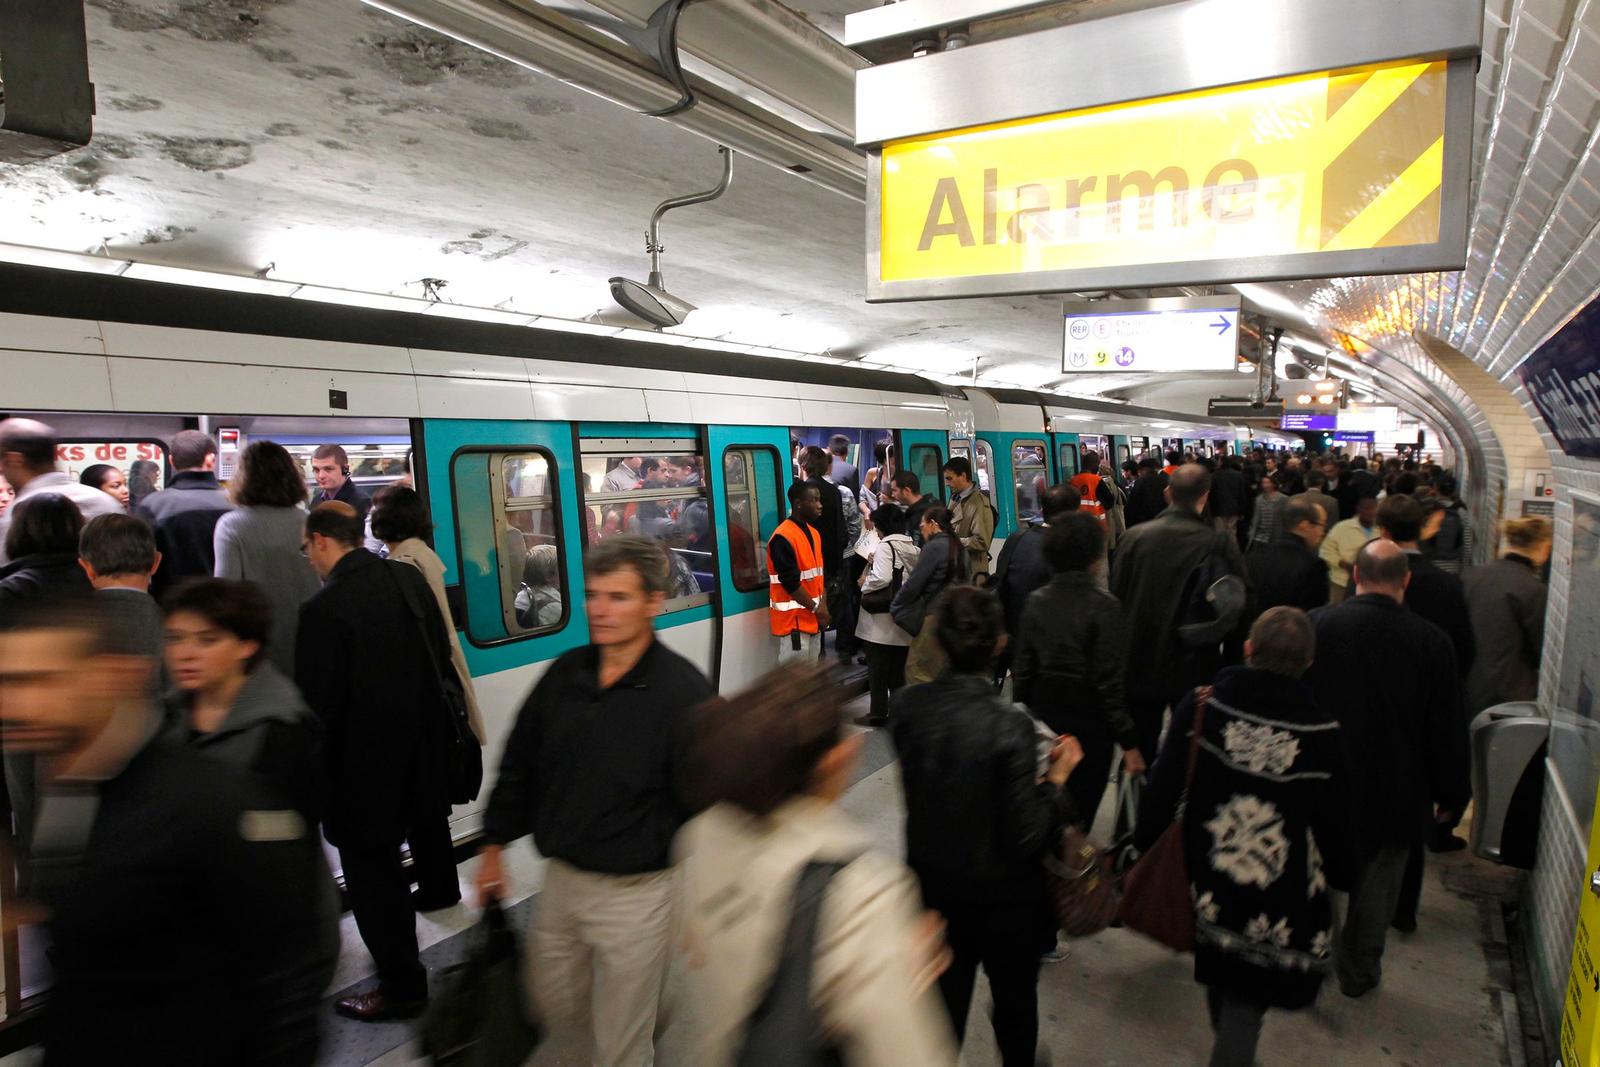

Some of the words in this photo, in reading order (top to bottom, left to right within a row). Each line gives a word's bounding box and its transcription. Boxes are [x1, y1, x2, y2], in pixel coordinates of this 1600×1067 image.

[917, 158, 1257, 251] Alarme
[1118, 350, 1134, 365] 14
[95, 443, 127, 461] de
